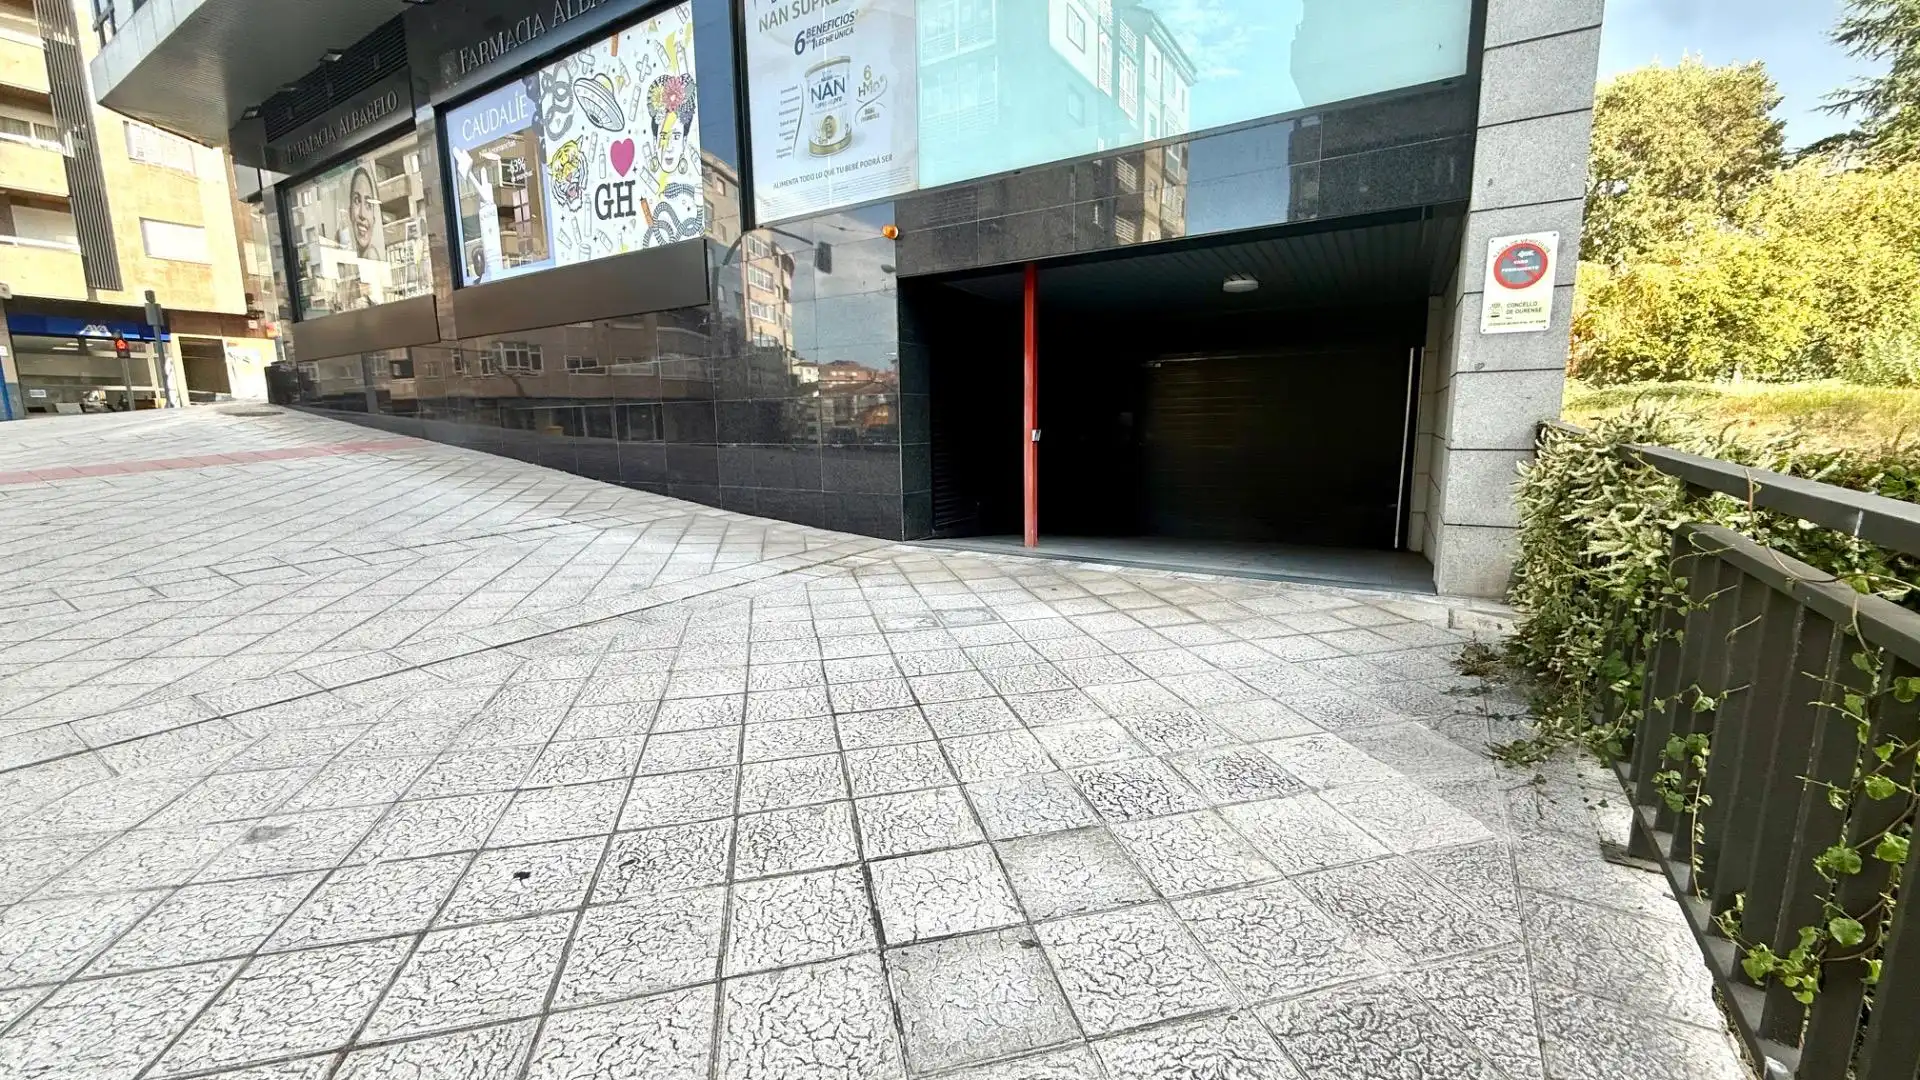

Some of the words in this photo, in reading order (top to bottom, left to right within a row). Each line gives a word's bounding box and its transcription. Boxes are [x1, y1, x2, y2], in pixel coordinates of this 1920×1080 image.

[759, 5, 789, 33] NAN
[459, 12, 546, 74] FARMACIA
[794, 30, 806, 56] 6
[810, 76, 846, 104] NAN
[773, 177, 799, 190] ALIMENTA
[799, 173, 815, 184] TODO
[815, 171, 823, 179] LO
[836, 165, 844, 174] TU
[860, 156, 881, 169] PODRÁ
[881, 153, 893, 164] SER
[595, 180, 637, 220] GH
